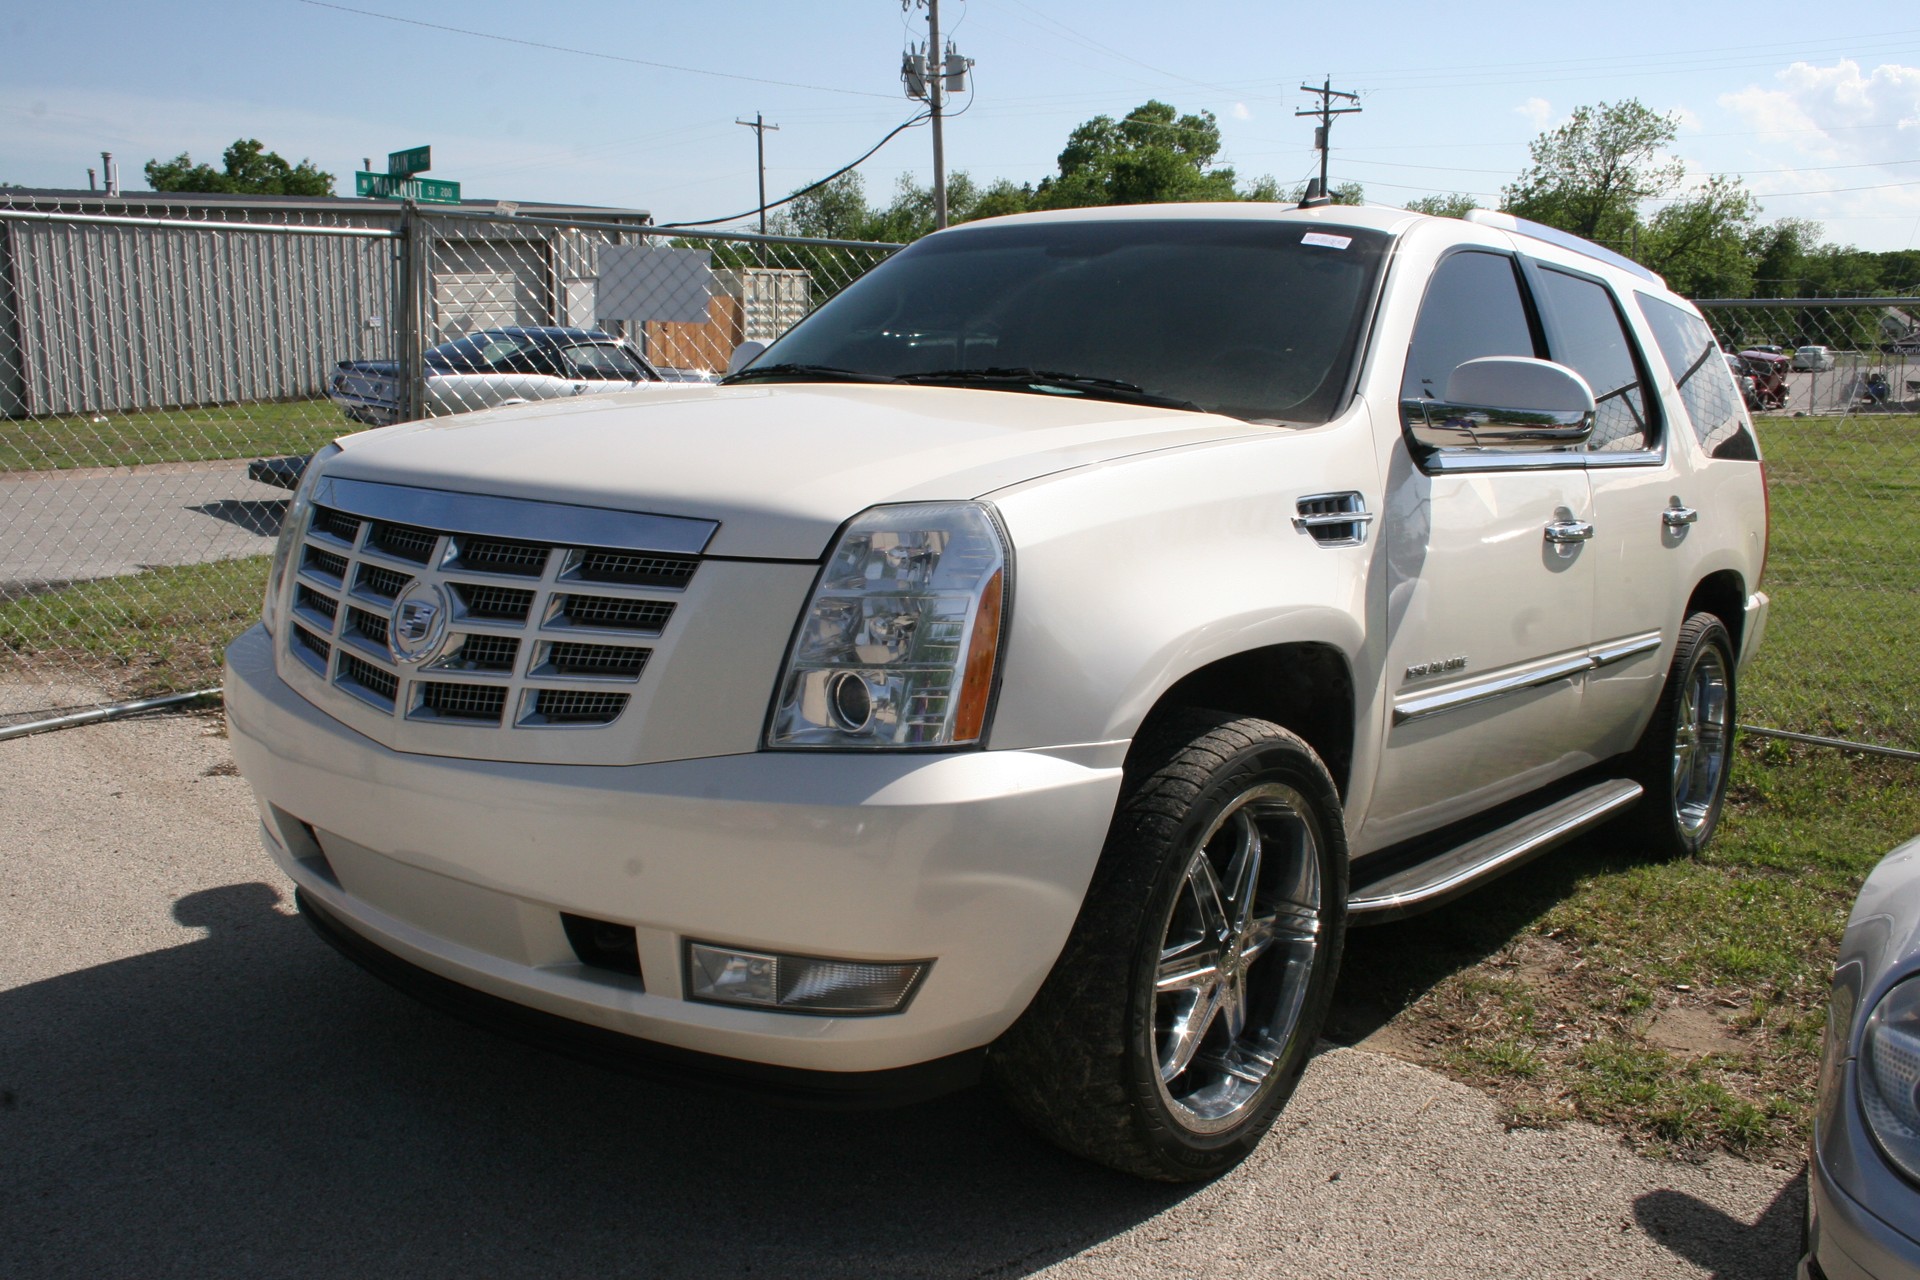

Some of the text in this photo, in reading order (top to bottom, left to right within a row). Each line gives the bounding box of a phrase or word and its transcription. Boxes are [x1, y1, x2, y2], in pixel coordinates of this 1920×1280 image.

[388, 153, 409, 174] MAIN
[361, 176, 453, 199] W WALNUT ST 200
